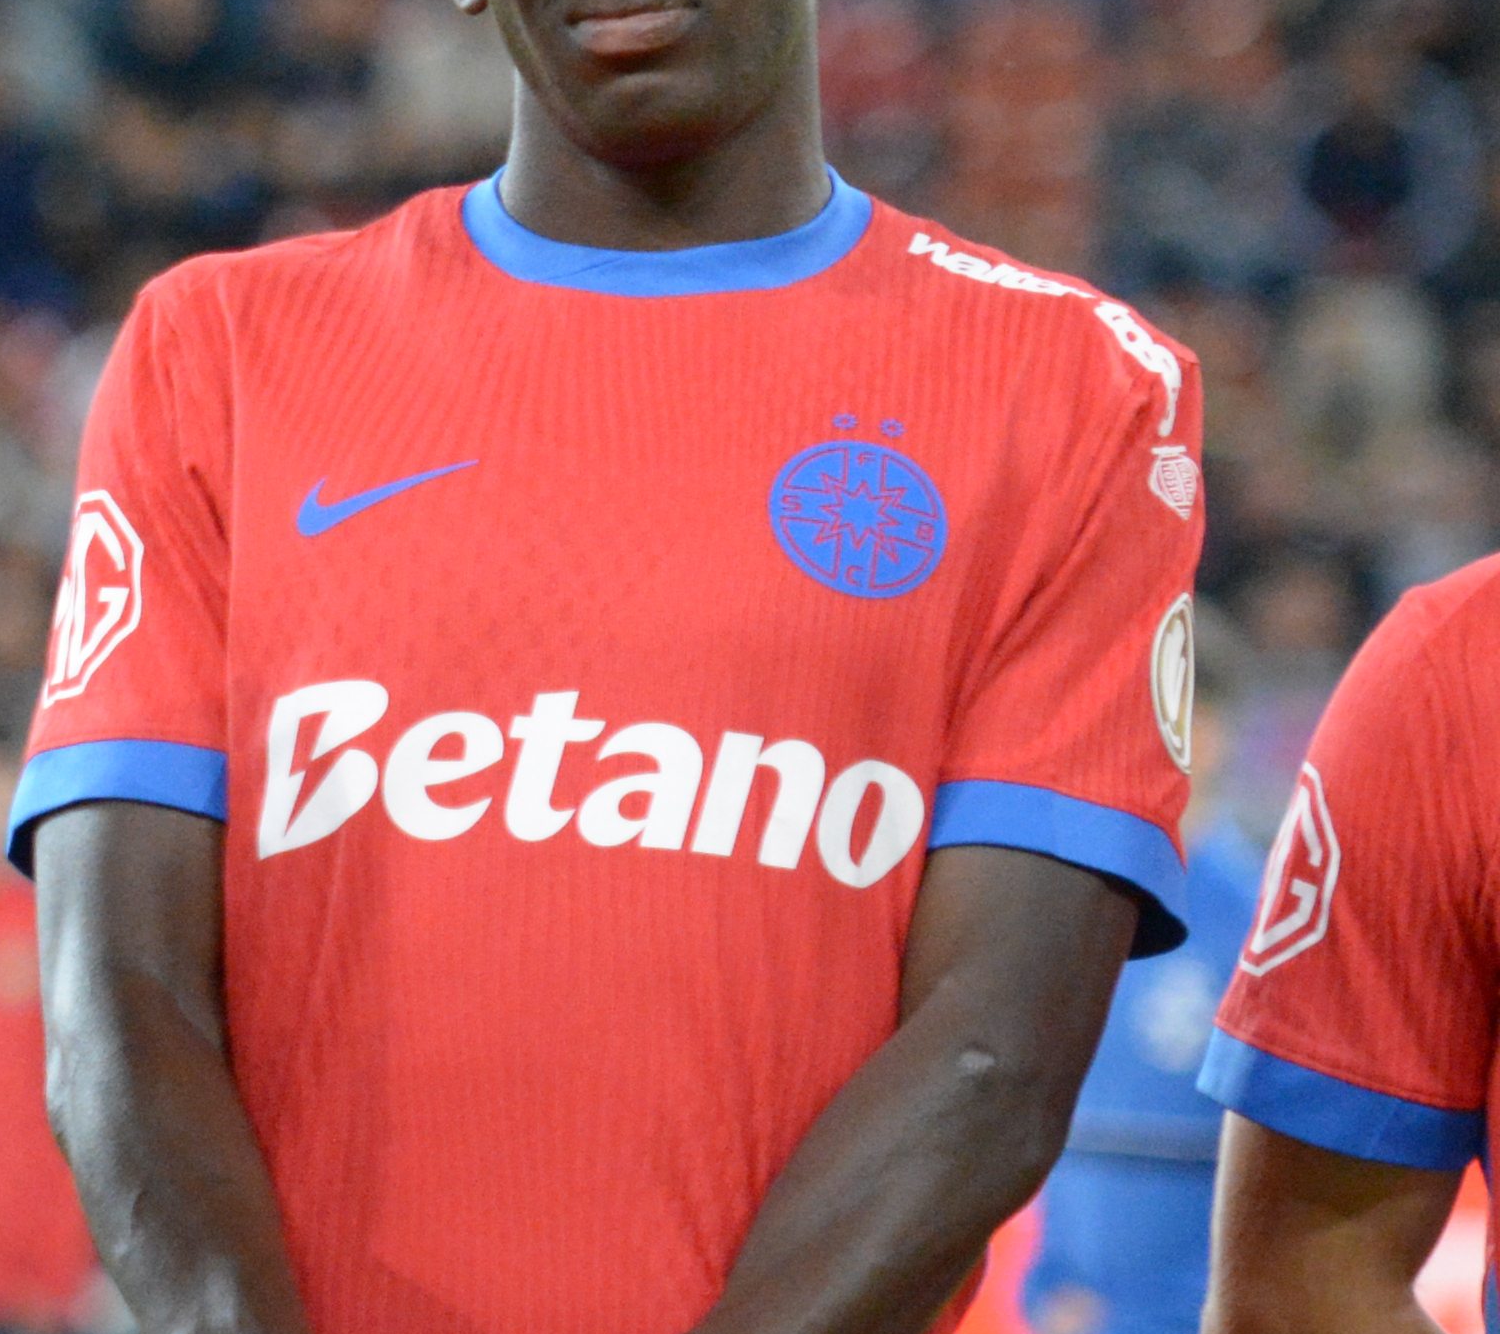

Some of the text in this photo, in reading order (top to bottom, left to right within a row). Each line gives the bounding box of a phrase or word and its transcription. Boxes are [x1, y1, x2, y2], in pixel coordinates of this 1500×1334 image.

[907, 231, 1097, 299] walter
[856, 452, 876, 467] F
[781, 494, 935, 543] S B
[844, 565, 865, 587] C
[257, 678, 926, 888] Betano
